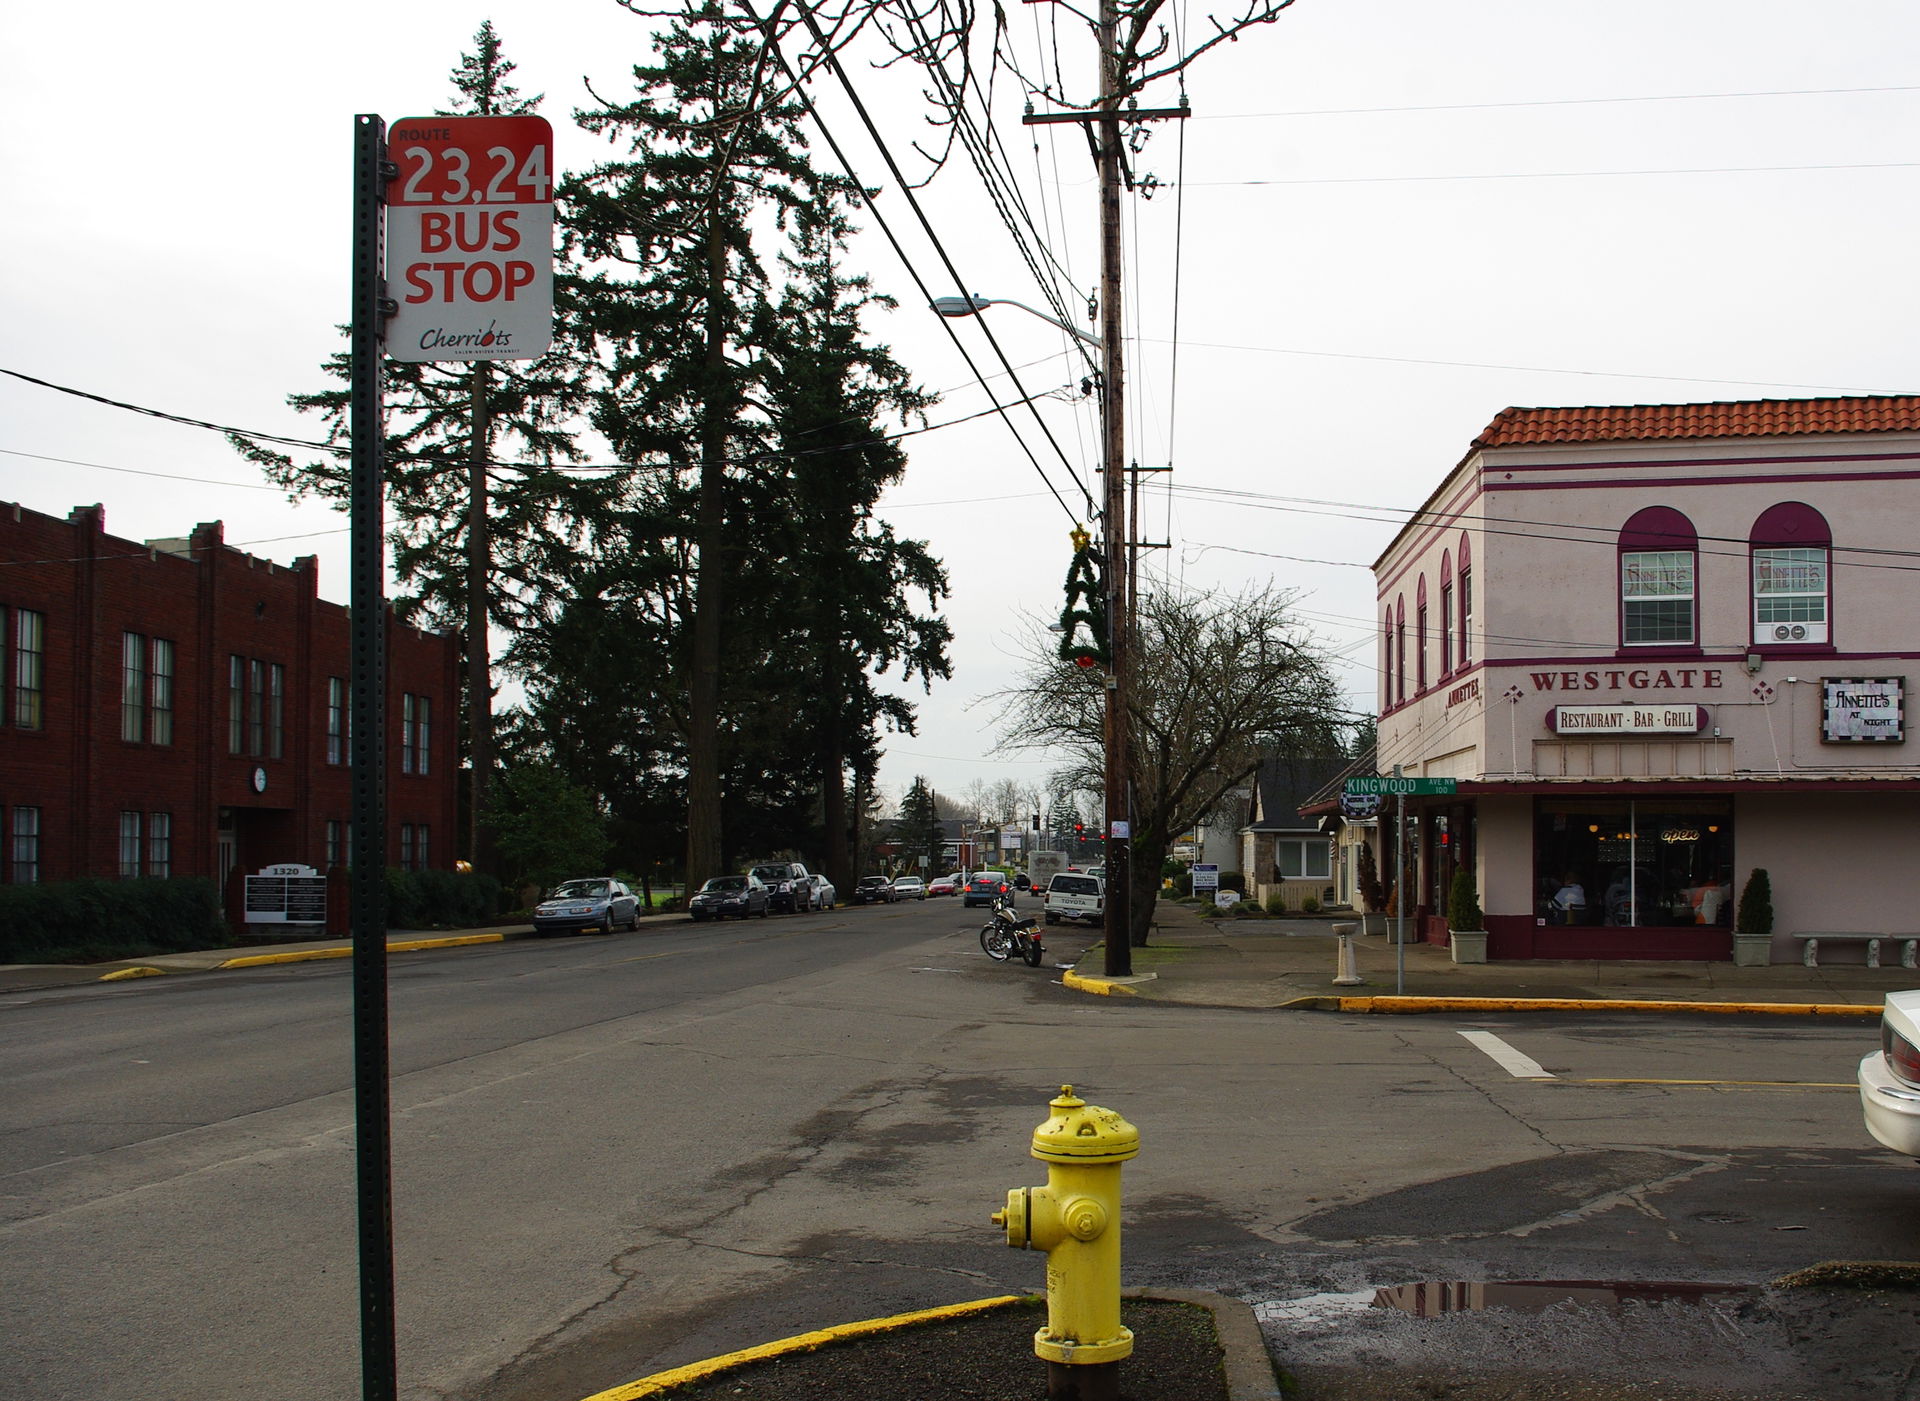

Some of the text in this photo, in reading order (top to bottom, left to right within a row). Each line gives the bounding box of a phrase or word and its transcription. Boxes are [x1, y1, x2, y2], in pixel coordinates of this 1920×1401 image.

[400, 128, 451, 142] ROUTE
[403, 144, 551, 205] 23,24
[421, 210, 521, 253] BUS
[404, 260, 535, 304] STOP
[420, 322, 513, 350] Cherriots
[1758, 560, 1820, 592] ANNETTE'S
[1530, 669, 1723, 691] WESTGATE
[1836, 690, 1890, 709] ANNETTE'S
[1561, 711, 1694, 728] RESTAURANT BAR GRILL
[1849, 711, 1861, 719] AT
[1863, 718, 1891, 727] NIGHT
[1347, 779, 1417, 793] KINGWOOD
[1435, 786, 1449, 794] 100
[1661, 828, 1700, 844] open
